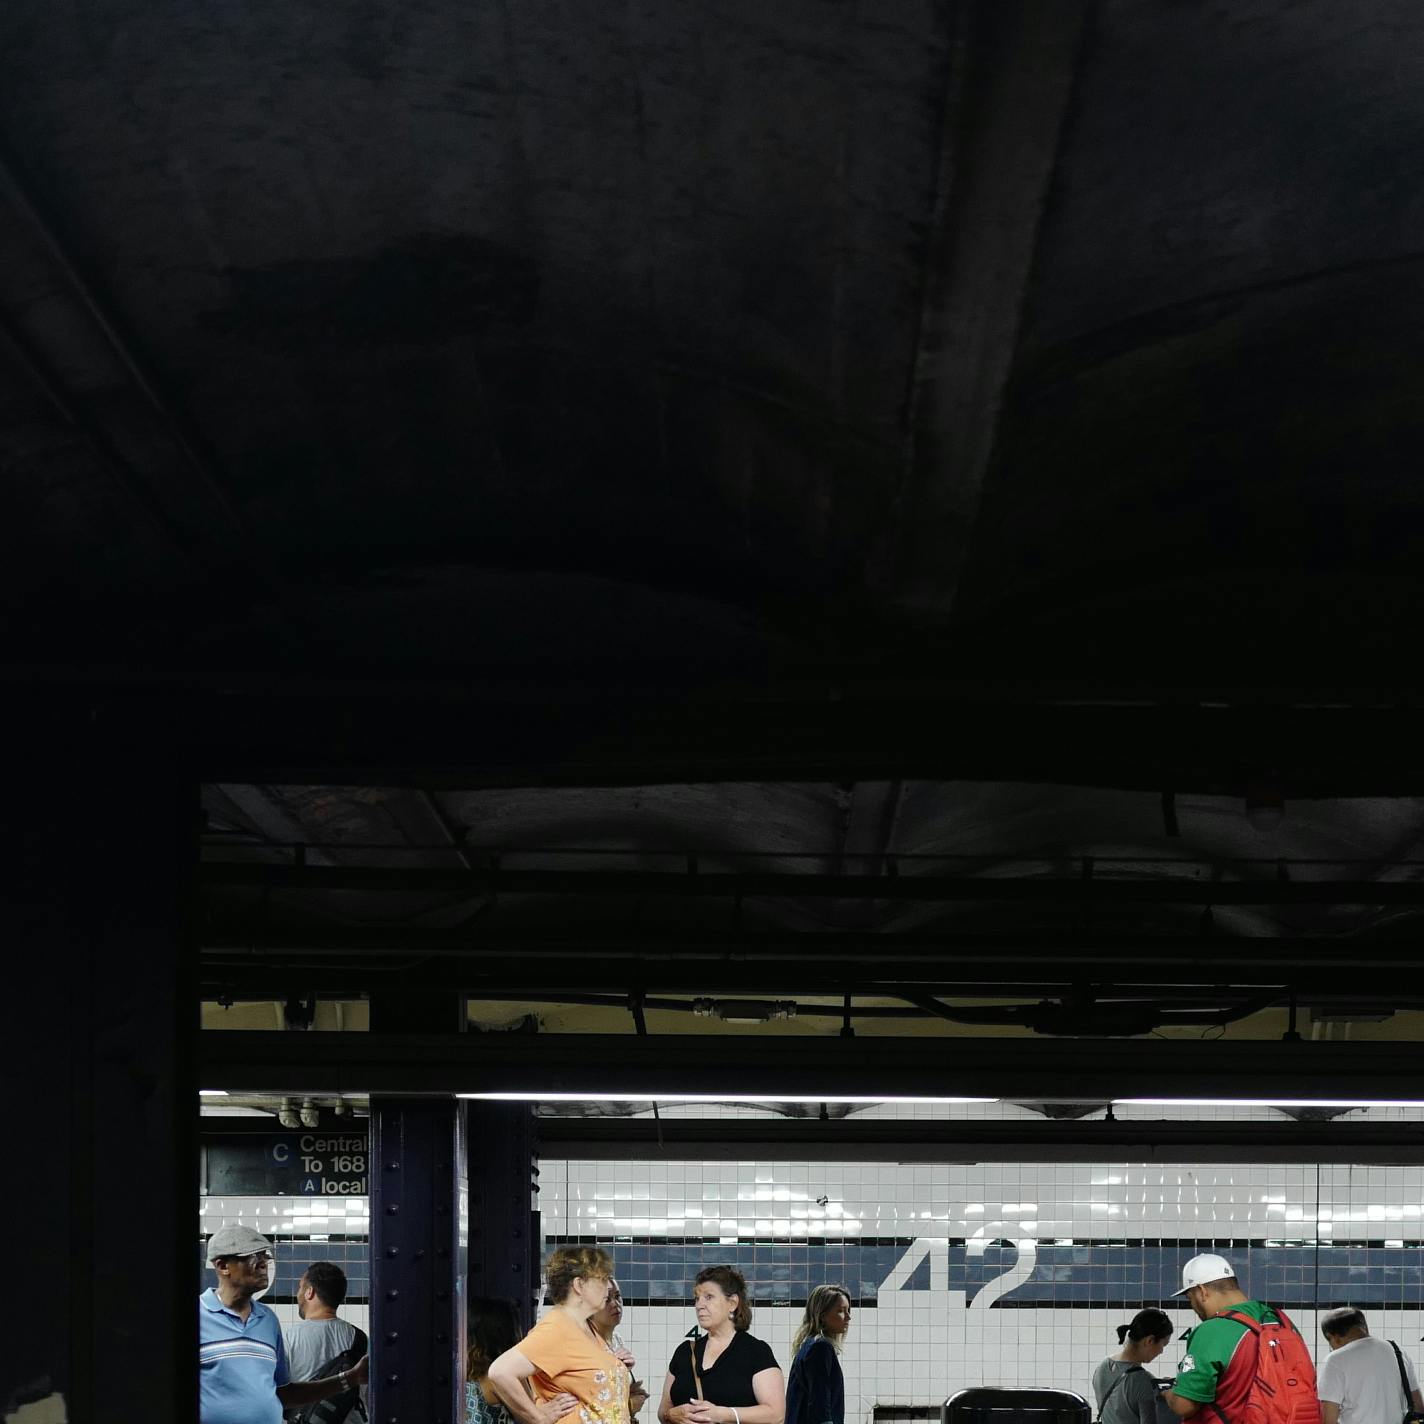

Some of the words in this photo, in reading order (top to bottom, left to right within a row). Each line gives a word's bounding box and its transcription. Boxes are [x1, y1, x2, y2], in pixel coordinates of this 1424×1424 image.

[273, 1143, 289, 1162] C
[300, 1135, 367, 1152] Central
[300, 1156, 323, 1173] To
[331, 1155, 365, 1173] 168
[304, 1179, 315, 1192] A
[321, 1177, 366, 1194] local
[878, 1221, 1038, 1310] 42
